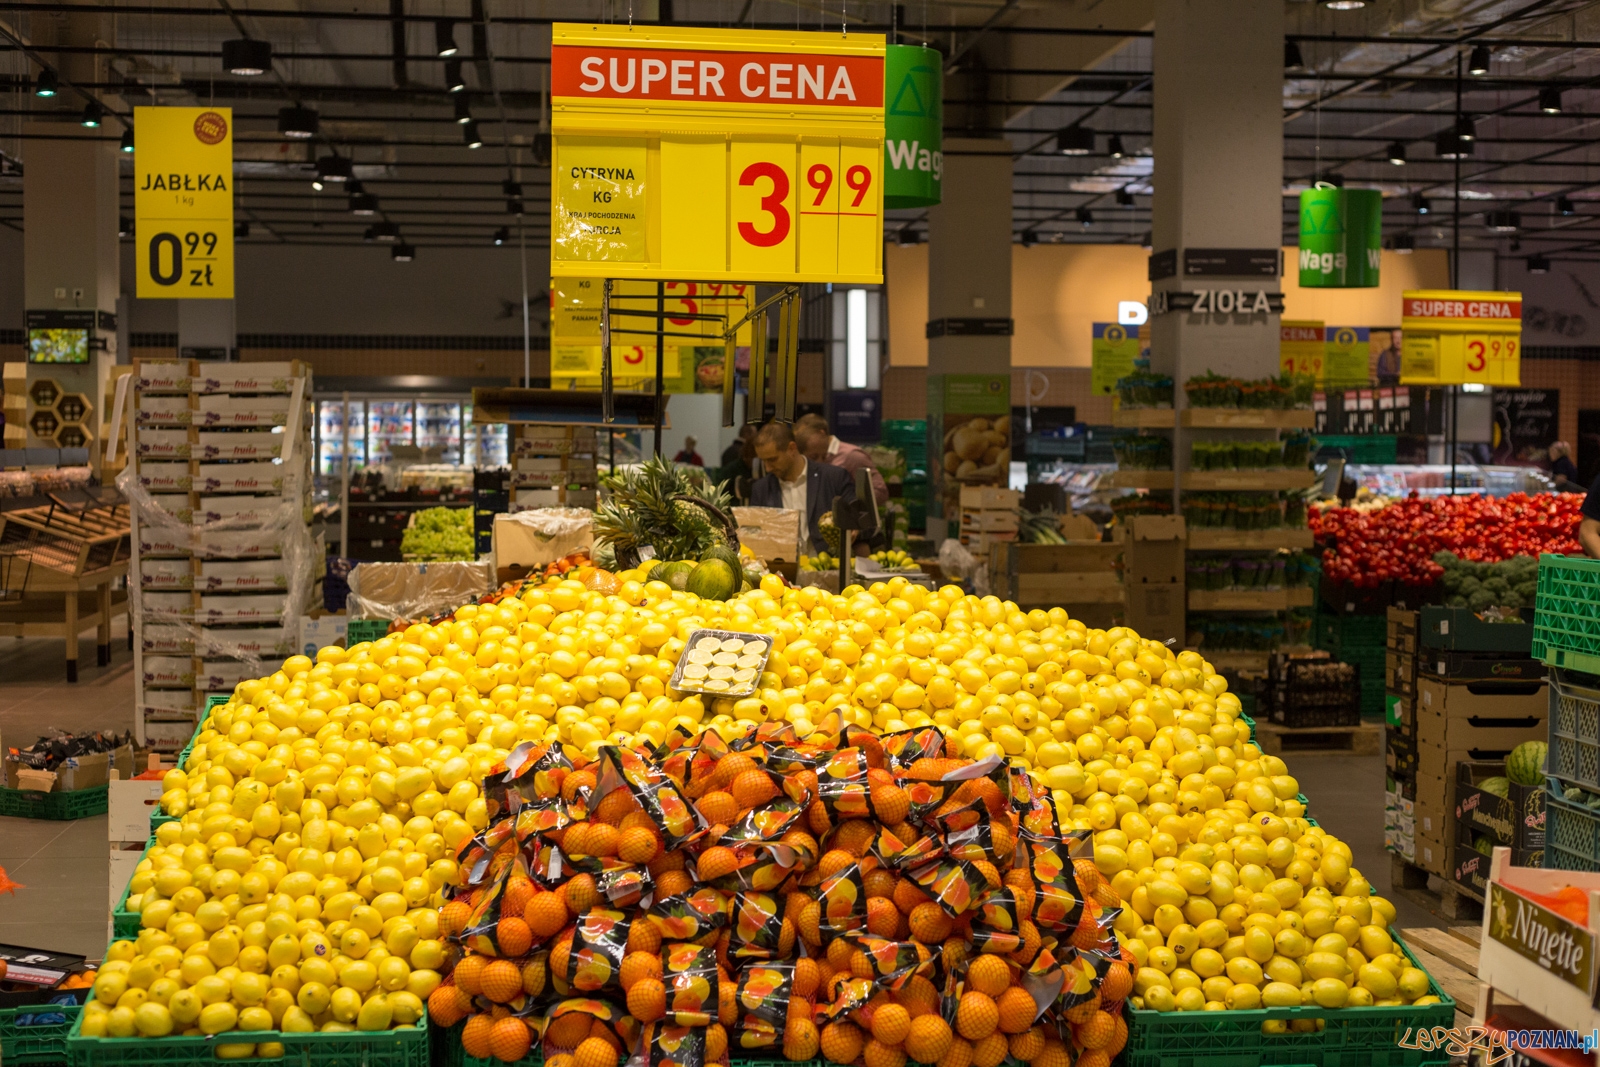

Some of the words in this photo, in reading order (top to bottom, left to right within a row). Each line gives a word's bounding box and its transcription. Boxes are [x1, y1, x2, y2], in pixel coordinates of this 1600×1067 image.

[580, 56, 726, 98] SUPER
[738, 62, 857, 101] CENA
[886, 139, 943, 181] Wag
[141, 174, 227, 191] JABŁKA
[571, 167, 635, 180] CYTRYNA
[183, 195, 194, 207] kg
[593, 191, 612, 203] KG
[737, 162, 790, 247] 3
[568, 211, 587, 219] KRAJ
[584, 225, 622, 235] URCJA
[149, 232, 183, 287] 0
[185, 232, 218, 256] 99
[1300, 248, 1348, 275] Waga
[190, 264, 214, 287] zł
[579, 280, 592, 289] KG
[1192, 289, 1271, 314] ZIOŁA
[1412, 301, 1465, 317] SUPER
[1468, 303, 1512, 318] CENA
[1467, 341, 1486, 372] 3
[1511, 899, 1584, 974] Ninette
